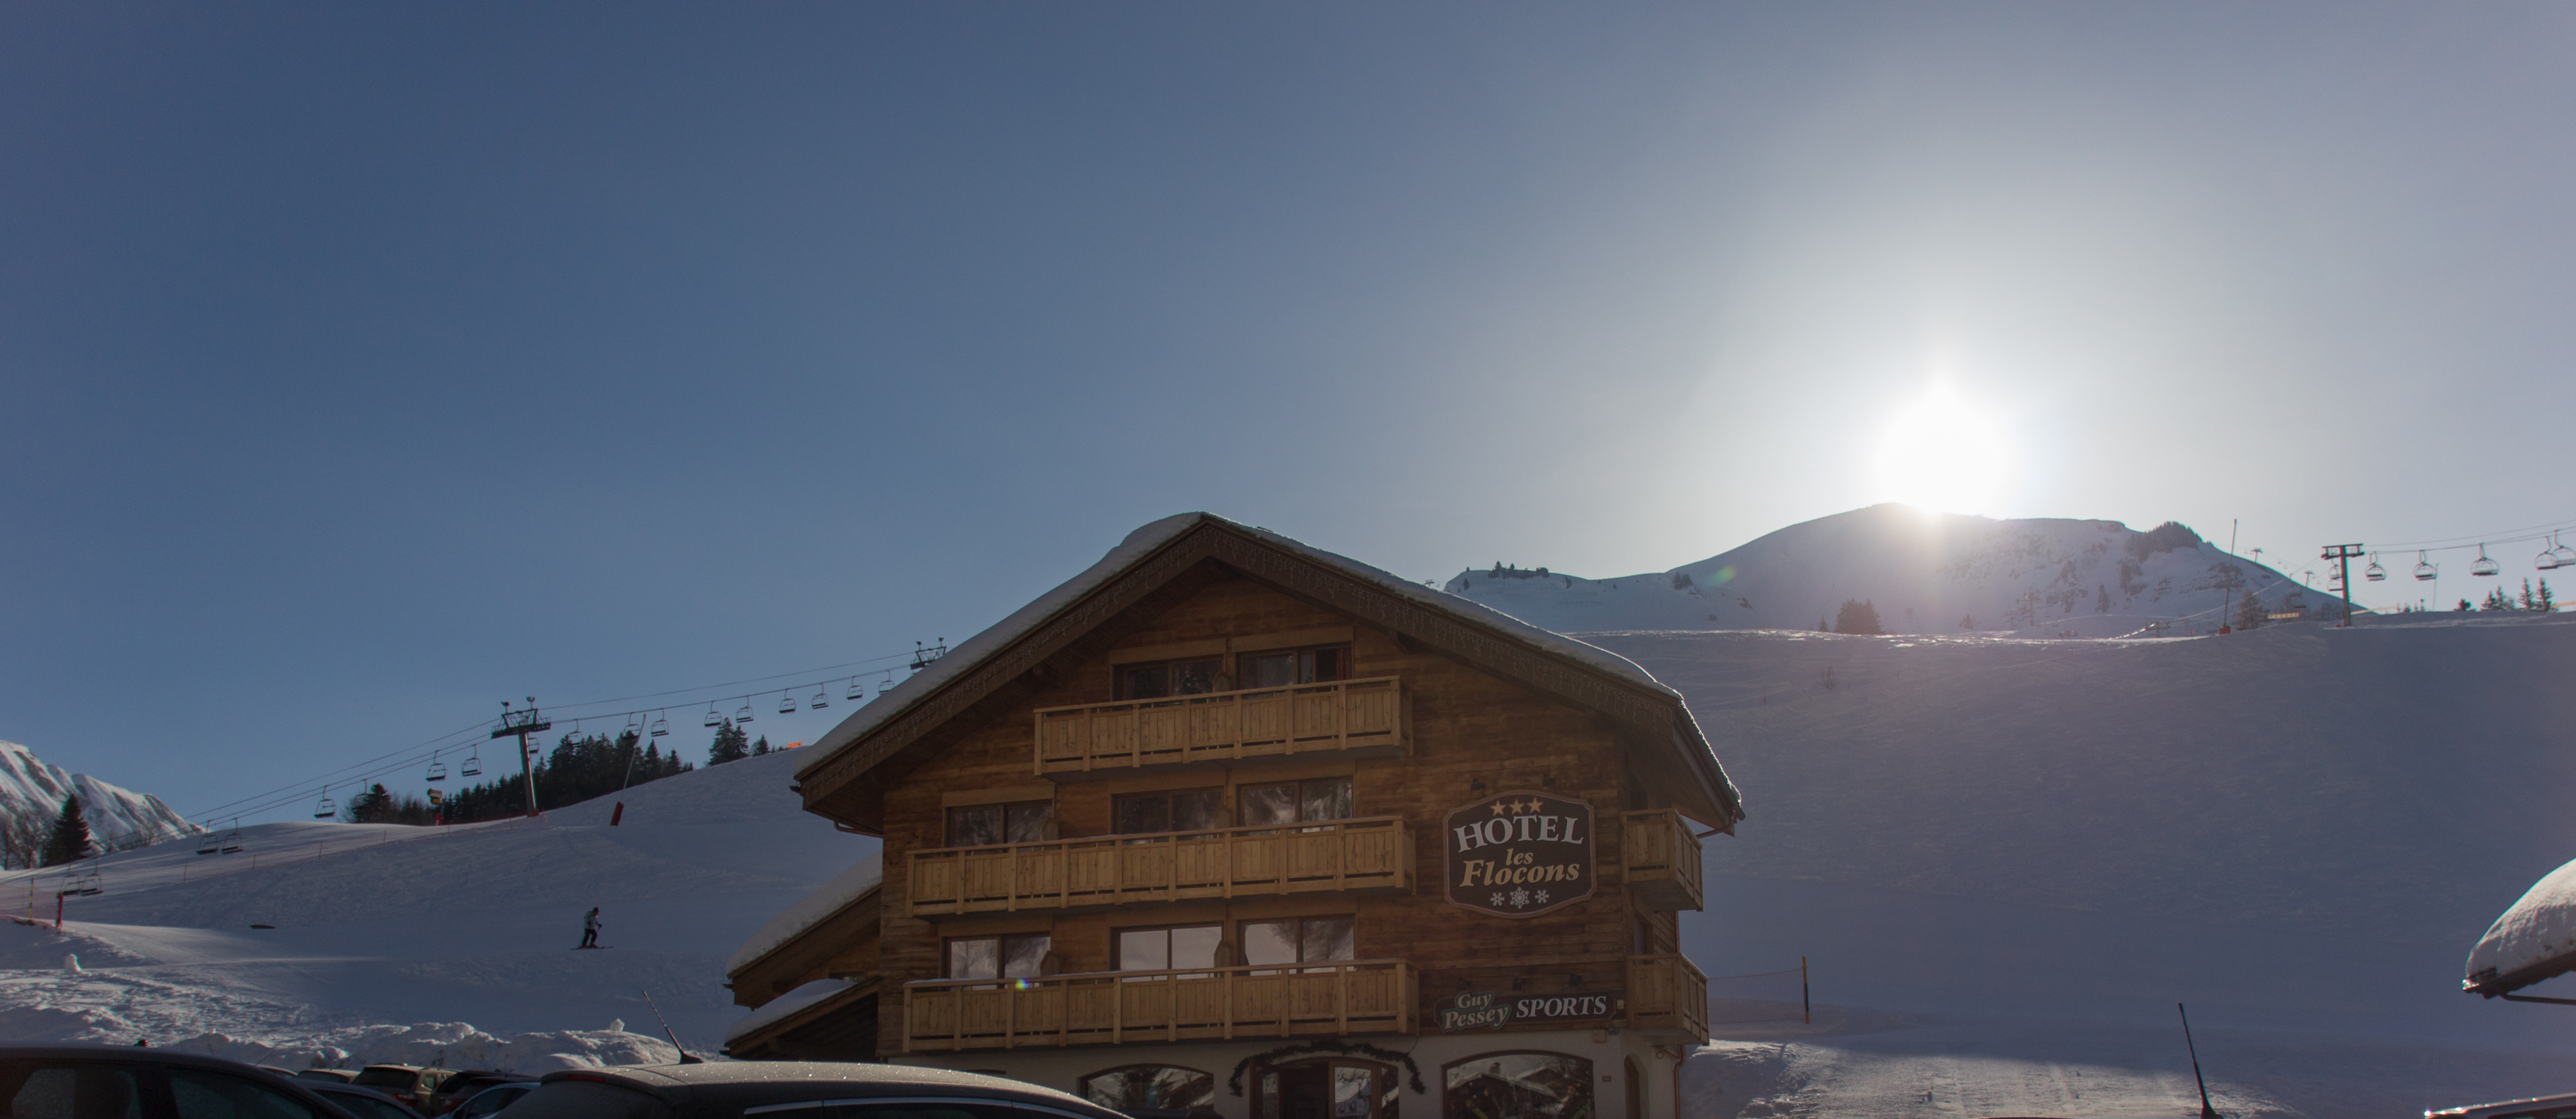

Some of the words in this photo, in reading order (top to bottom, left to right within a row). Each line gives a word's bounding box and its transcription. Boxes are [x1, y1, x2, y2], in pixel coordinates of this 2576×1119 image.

[1453, 814, 1584, 853] HOTEL
[1505, 847, 1533, 866] les
[1458, 859, 1580, 887] Flocons
[1458, 993, 1491, 1010] Guy
[1516, 996, 1607, 1018] SPORTS
[1444, 1007, 1508, 1029] Pessey
